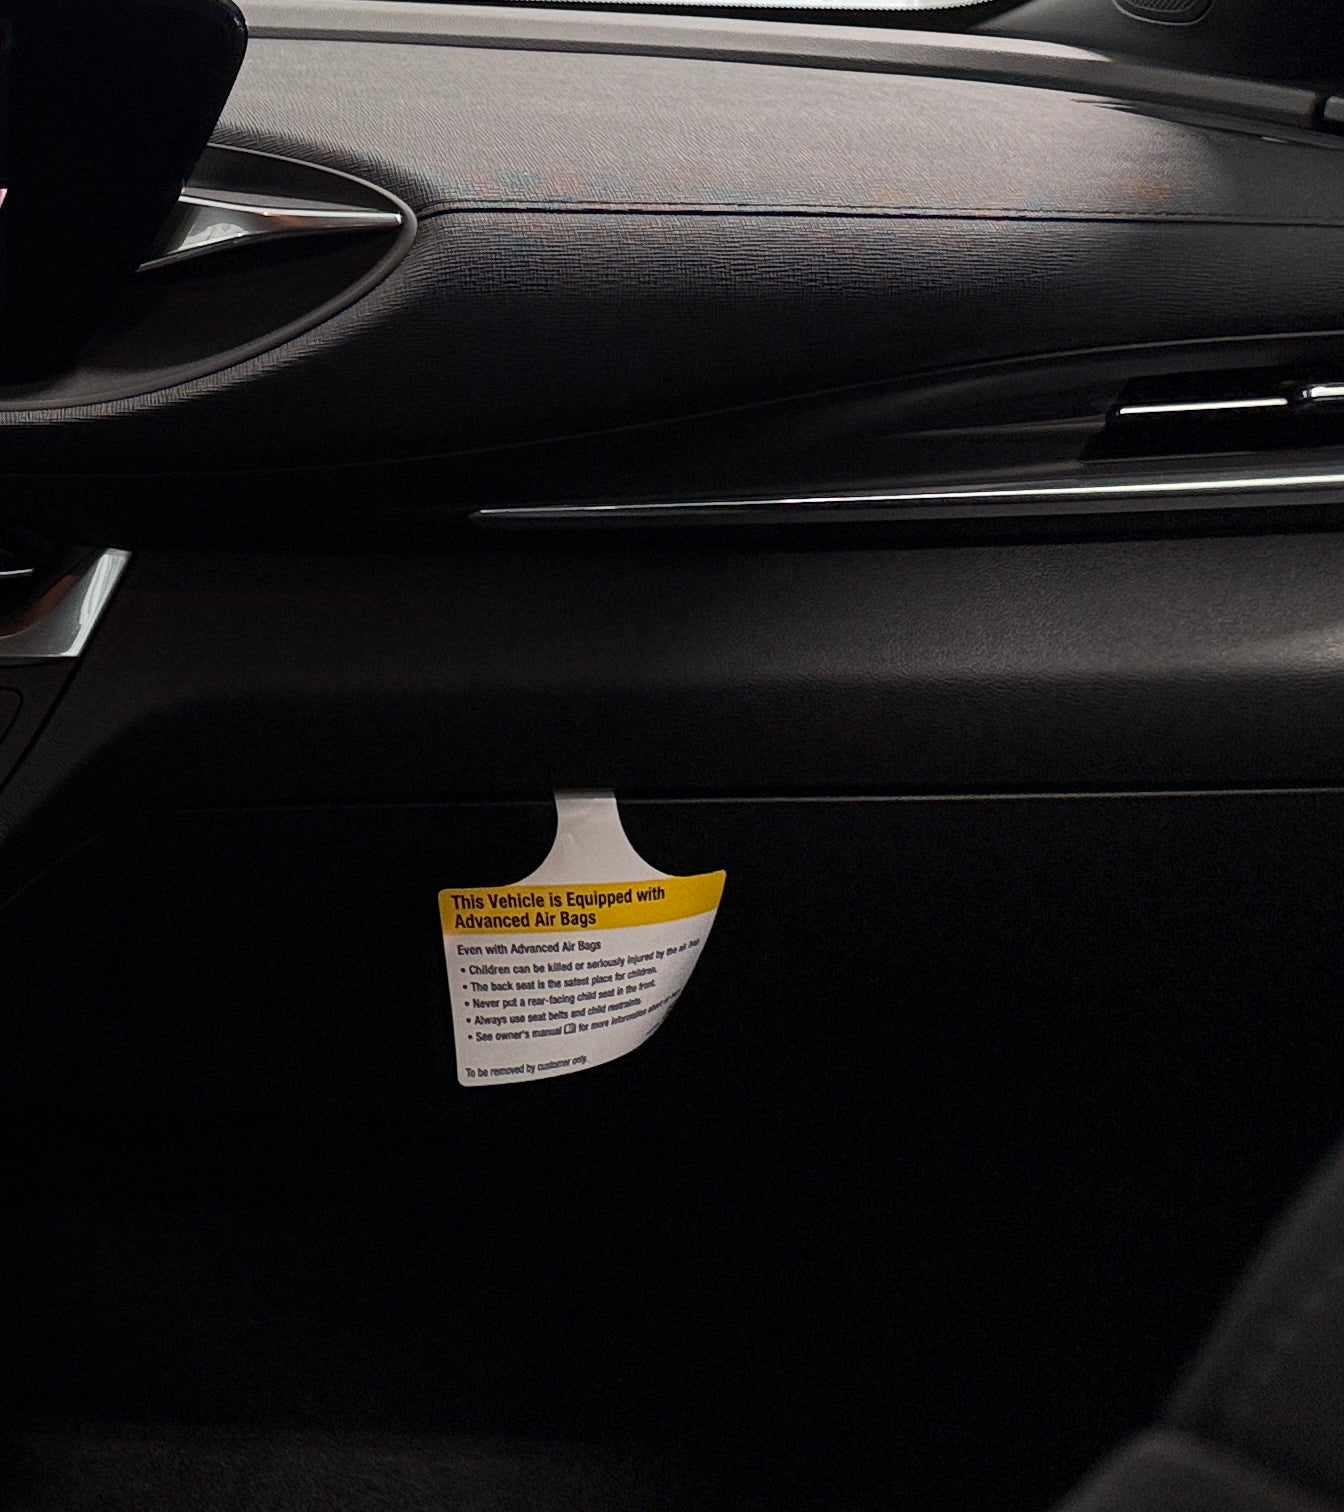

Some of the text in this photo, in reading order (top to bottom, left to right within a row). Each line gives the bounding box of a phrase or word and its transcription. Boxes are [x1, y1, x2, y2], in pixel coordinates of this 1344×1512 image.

[452, 886, 665, 910] This Vehicle is Equipped with
[455, 911, 596, 929] Advanced Air Bags
[457, 940, 601, 955] Even with Advanced Air Bags
[469, 964, 510, 975] Children
[533, 963, 545, 973] be
[547, 961, 573, 972] killed
[575, 962, 585, 970] or
[587, 956, 624, 969] seriously
[627, 951, 654, 965] injured
[655, 950, 665, 961] by
[470, 981, 490, 992] The
[492, 980, 513, 991] back
[516, 981, 536, 990] seat
[538, 980, 545, 989] is
[548, 979, 562, 988] the
[564, 977, 589, 987] safest
[591, 974, 612, 986] place
[615, 971, 625, 981] for
[473, 998, 499, 1009] Never
[502, 999, 517, 1009] put
[528, 994, 574, 1007] rear-facing
[577, 991, 596, 1002] child
[599, 989, 615, 999] seat
[617, 987, 624, 996] in
[626, 983, 637, 994] the
[474, 1015, 507, 1026] Always
[510, 1015, 525, 1024] use
[528, 1013, 546, 1022] seat
[548, 1010, 568, 1020] belts
[571, 1008, 586, 1018] and
[588, 1004, 606, 1016] child
[476, 1031, 493, 1042] See
[495, 1030, 529, 1041] owner's
[532, 1027, 562, 1038] manual
[579, 1022, 589, 1032] for
[466, 1068, 475, 1078] To
[478, 1067, 488, 1077] be
[490, 1064, 524, 1076] removed
[526, 1063, 536, 1074] by
